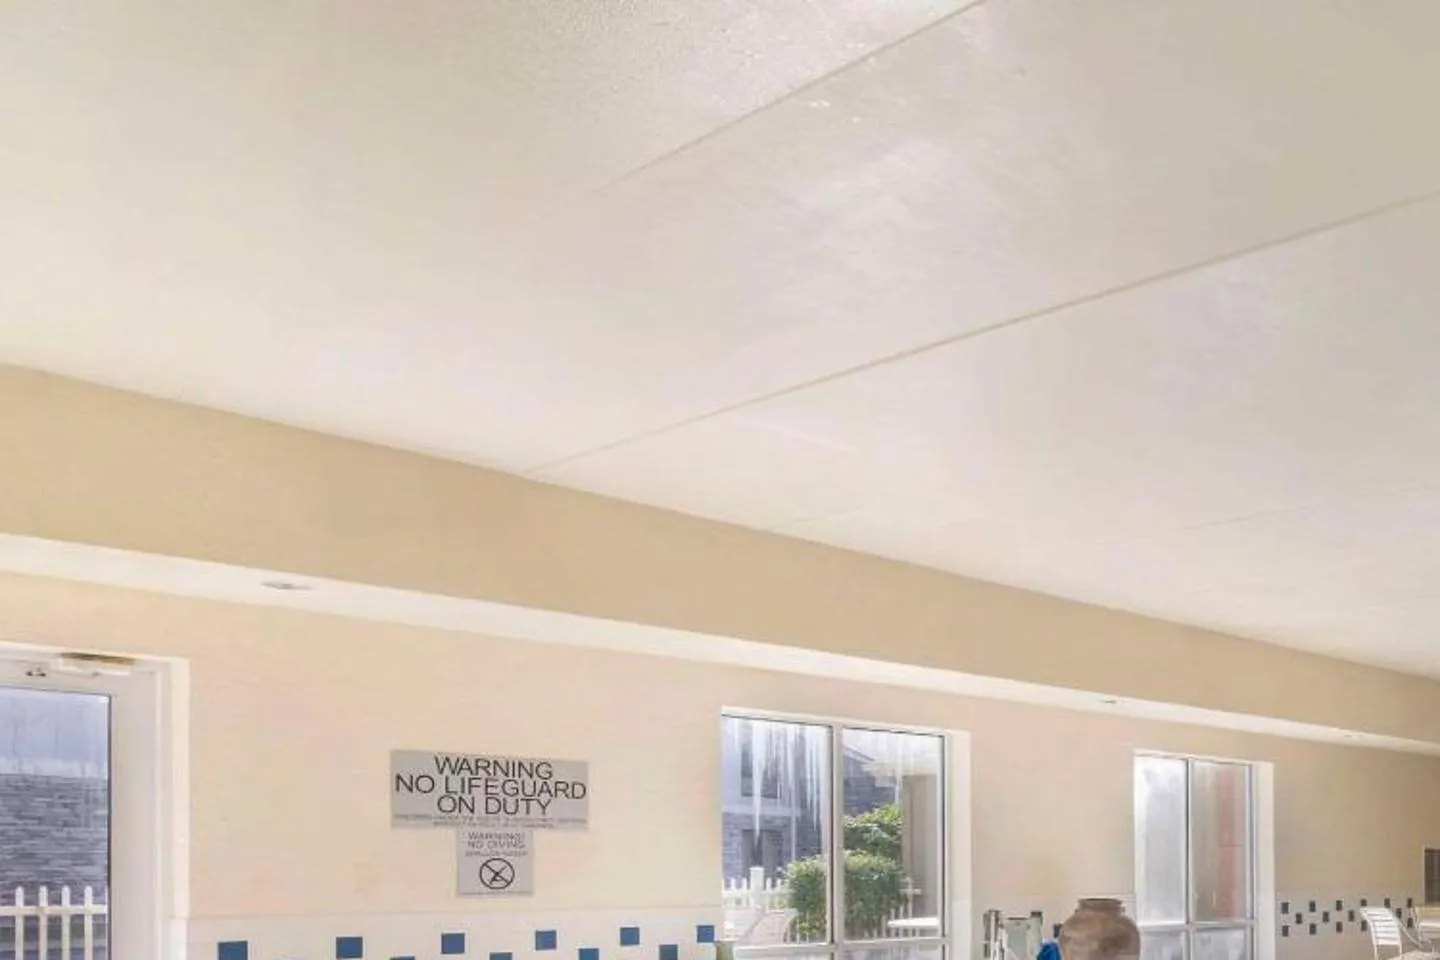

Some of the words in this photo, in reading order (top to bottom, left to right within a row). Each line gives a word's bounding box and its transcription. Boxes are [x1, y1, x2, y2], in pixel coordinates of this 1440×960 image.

[434, 755, 553, 780] WARNING
[395, 774, 435, 794] NO
[444, 776, 587, 800] LIFEGUARD
[437, 795, 476, 814] ON
[485, 797, 552, 816] DUTY
